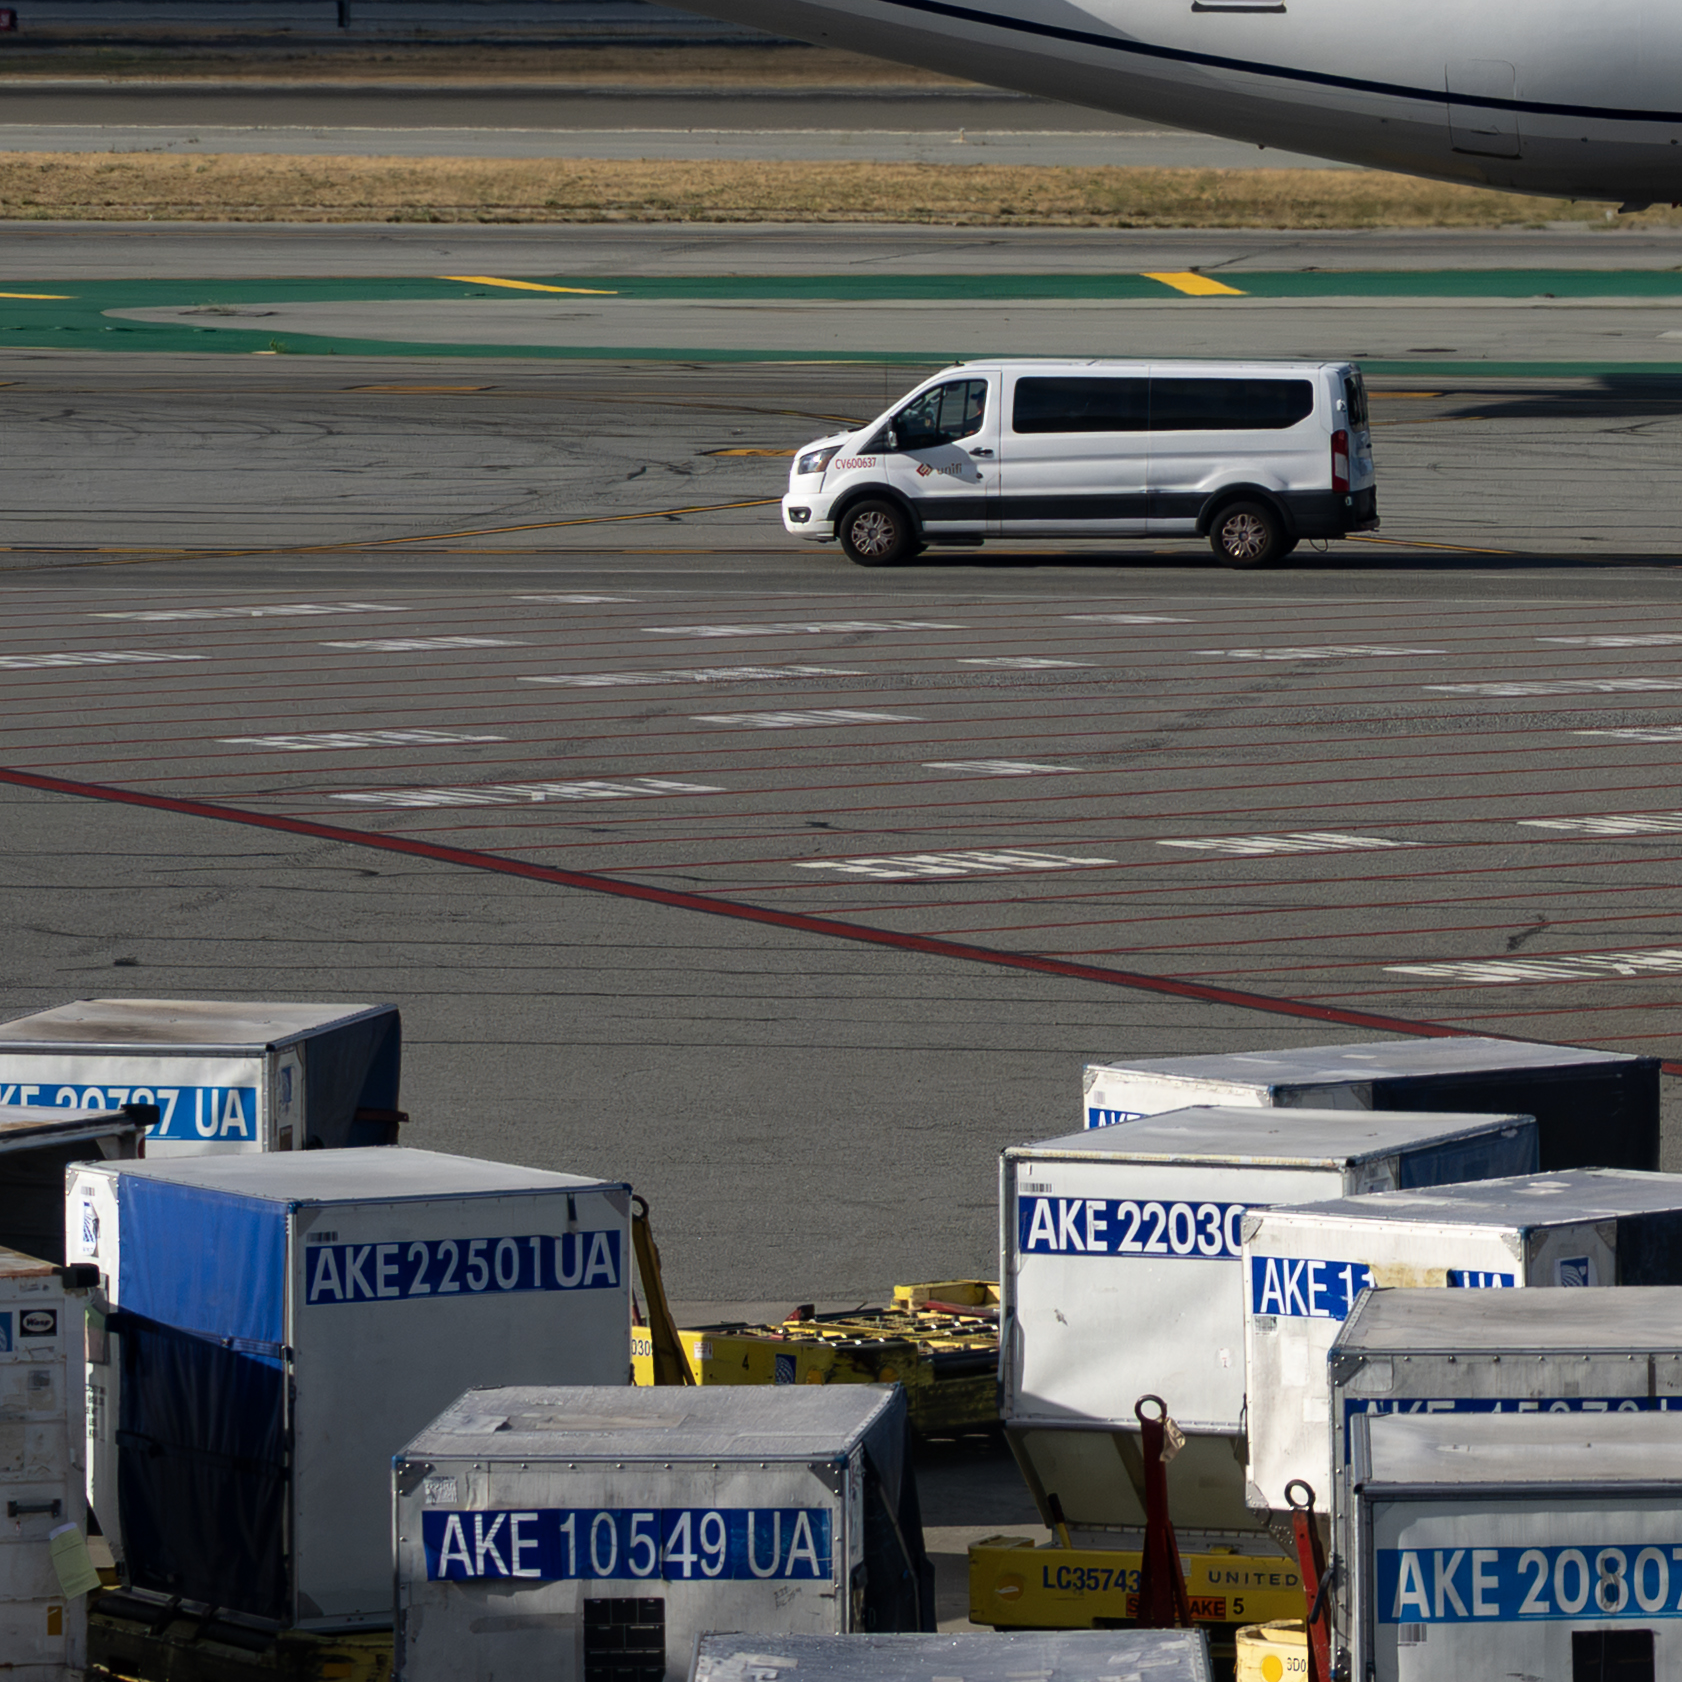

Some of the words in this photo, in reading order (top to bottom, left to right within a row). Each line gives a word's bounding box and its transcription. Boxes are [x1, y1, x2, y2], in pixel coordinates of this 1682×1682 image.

[835, 457, 877, 469] CV600637
[196, 1089, 248, 1137] UA
[1028, 1199, 1107, 1251] AKE
[310, 1244, 400, 1301] AKE
[408, 1237, 541, 1295] 22501
[555, 1231, 618, 1288] UA
[1261, 1258, 1330, 1316] AKE
[26, 1318, 51, 1327] Wasp
[438, 1512, 541, 1578] AKE
[560, 1511, 727, 1578] 10549
[748, 1510, 821, 1578] UA
[1208, 1570, 1299, 1588] UNITED
[1392, 1549, 1500, 1618] AKE
[1232, 1597, 1245, 1615] 5
